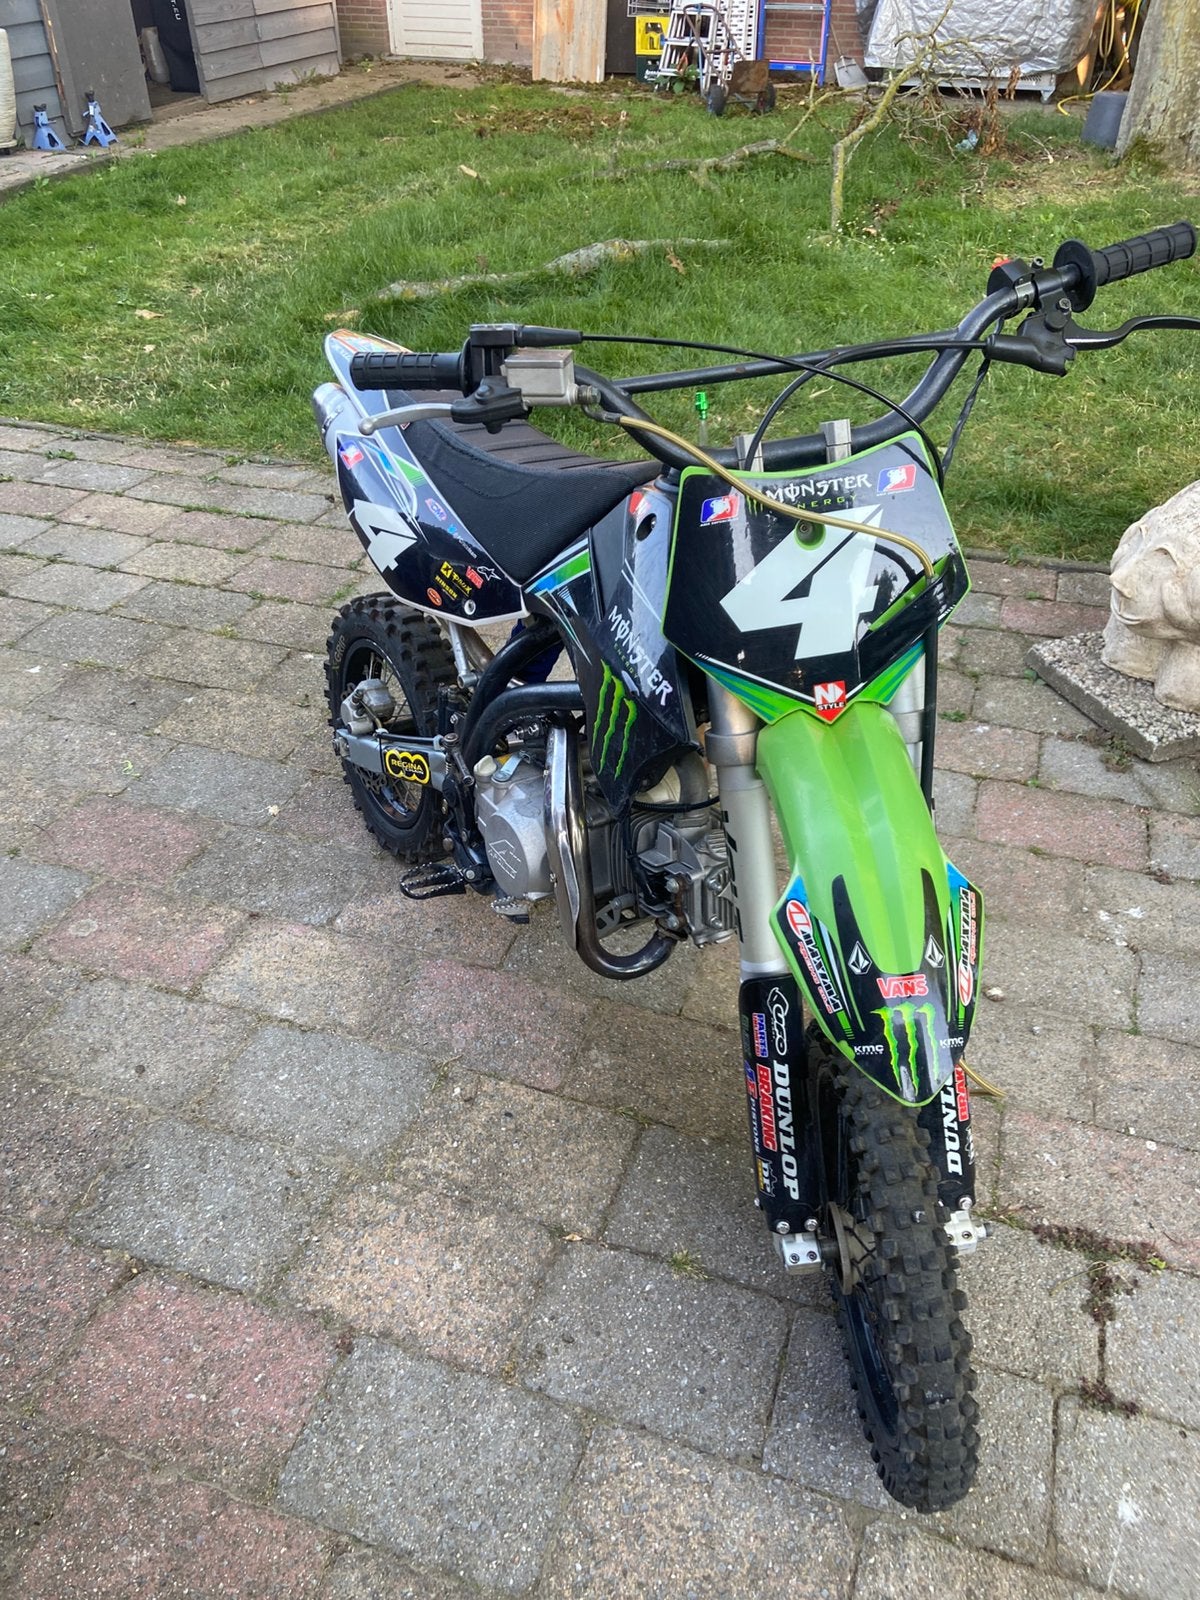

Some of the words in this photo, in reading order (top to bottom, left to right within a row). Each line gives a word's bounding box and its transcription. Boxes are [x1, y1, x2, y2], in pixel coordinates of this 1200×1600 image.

[795, 493, 858, 510] NERGY
[354, 499, 418, 573] 4
[719, 503, 884, 660] 4
[614, 643, 639, 679] ENERGY
[817, 702, 845, 711] STYLE
[391, 759, 423, 771] REGINA
[876, 974, 929, 998] VANS
[757, 1013, 769, 1057] PARTS
[772, 1003, 788, 1056] UFO
[757, 1063, 777, 1152] BRAKING
[955, 1064, 969, 1121] BRAK
[750, 1098, 760, 1153] PISTONS
[773, 1060, 799, 1200] DUNLOP
[941, 1072, 963, 1176] DUNL
